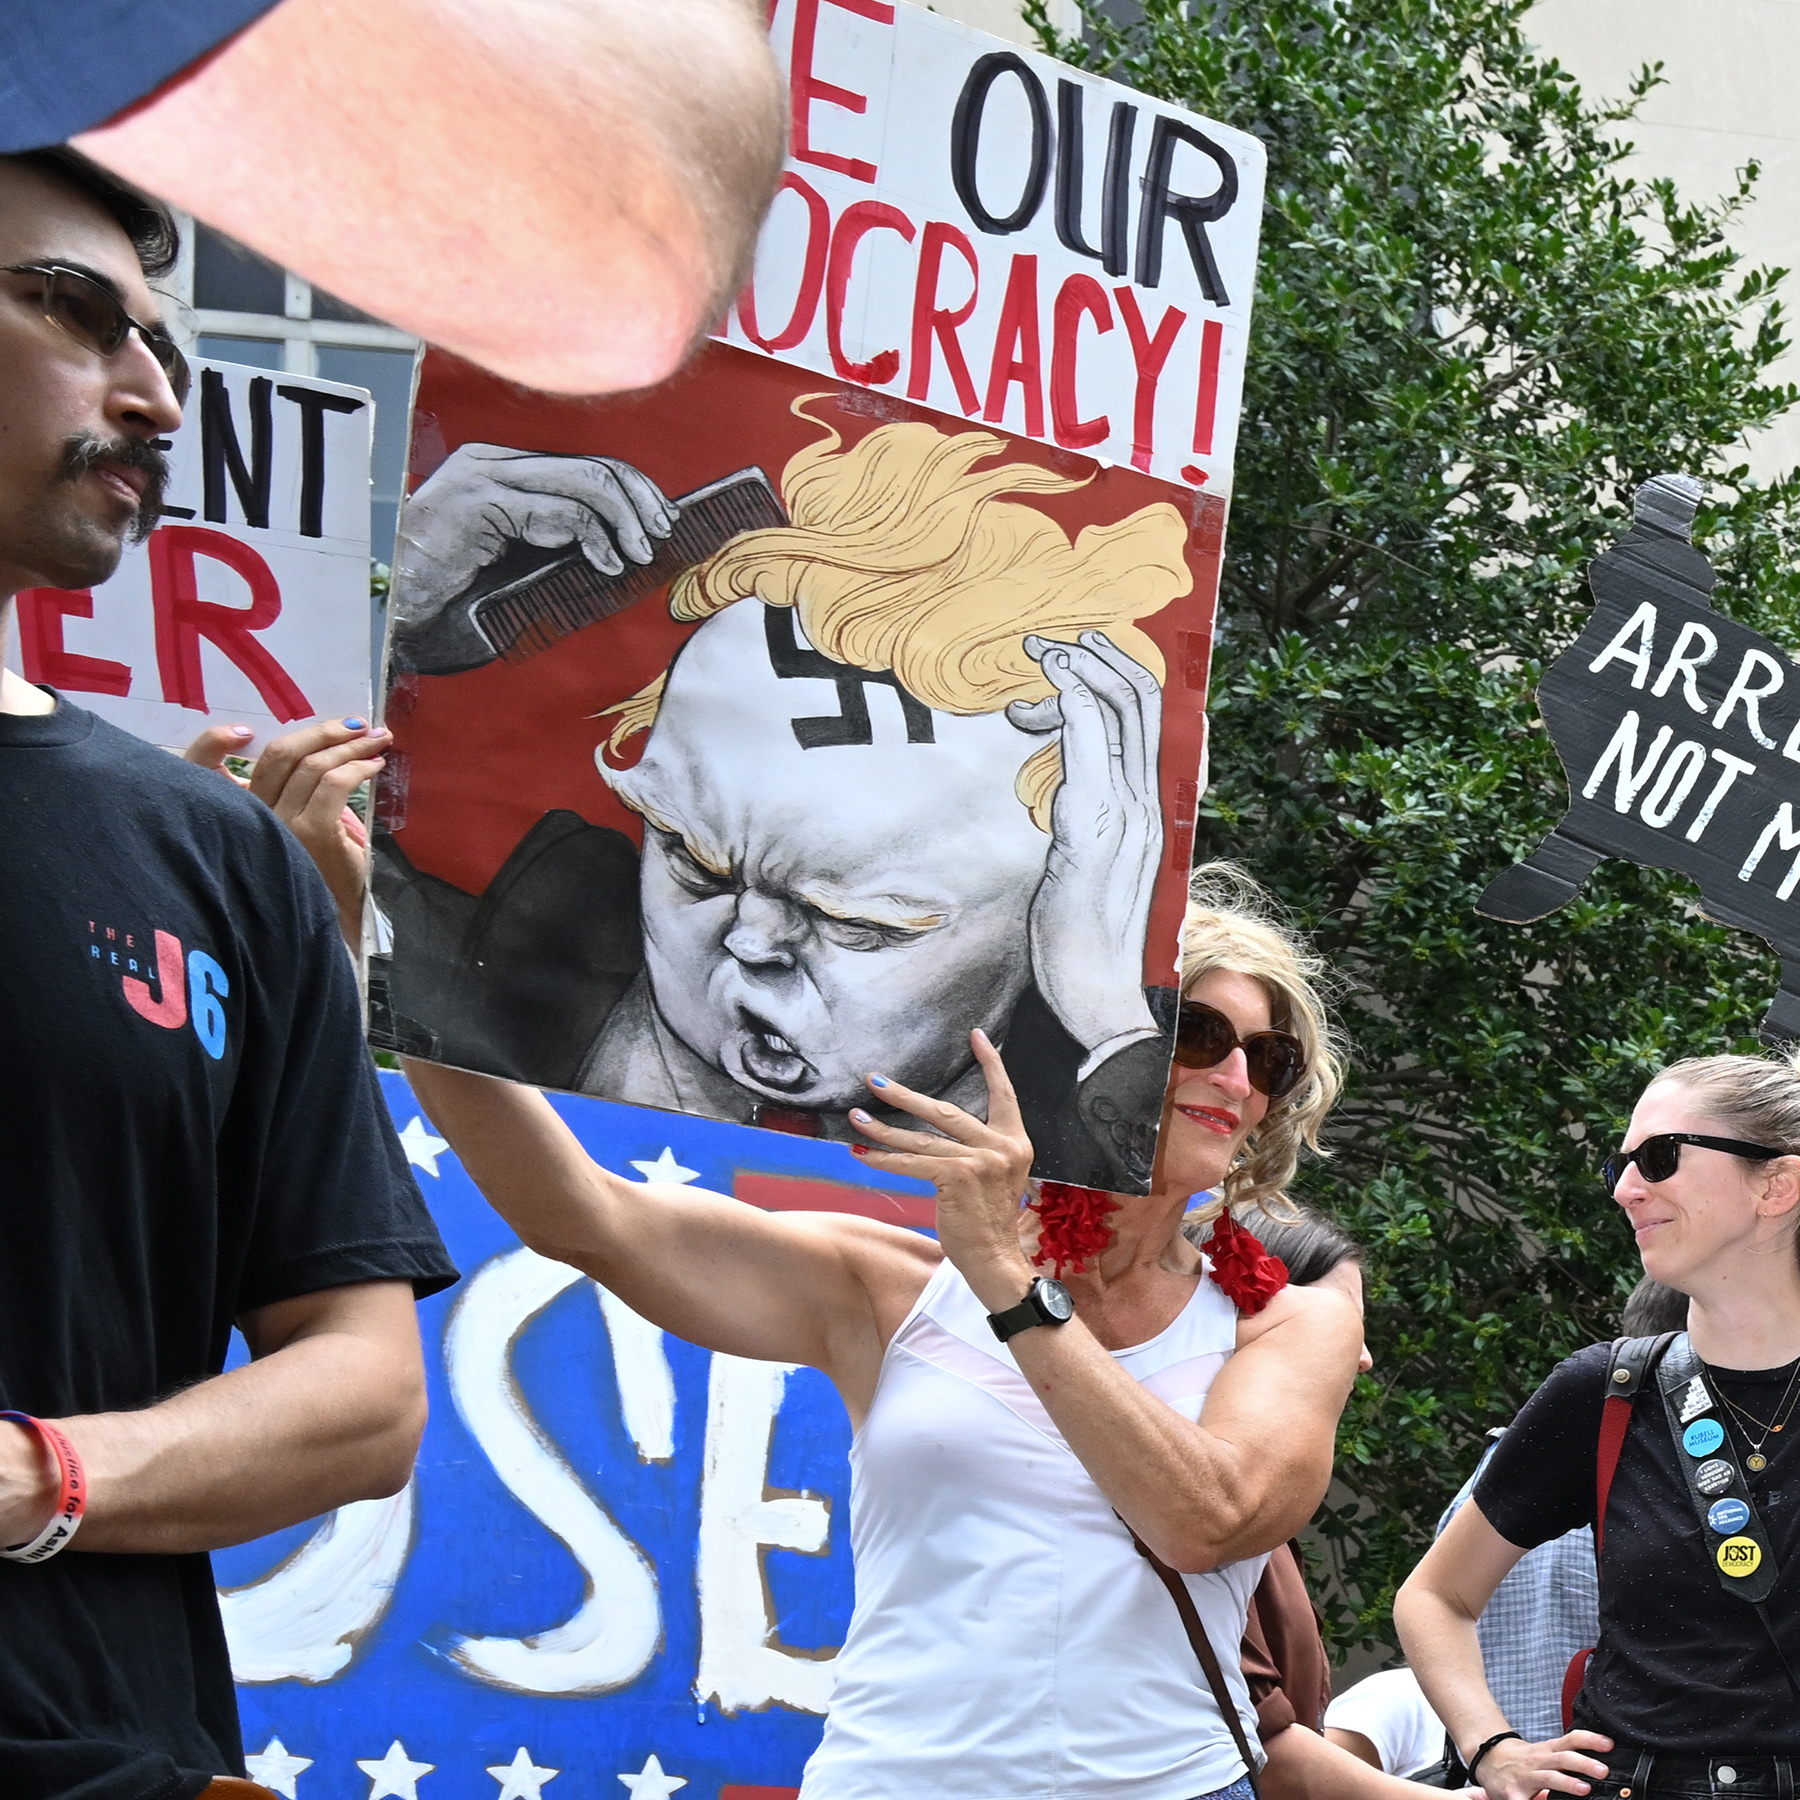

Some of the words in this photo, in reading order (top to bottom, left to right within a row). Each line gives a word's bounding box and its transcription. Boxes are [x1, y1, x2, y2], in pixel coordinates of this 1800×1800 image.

[768, 0, 895, 184] E
[950, 50, 1238, 307] OUR
[708, 171, 1224, 487] OCRACY!
[150, 366, 366, 538] NT
[1582, 710, 1756, 843] NOT
[88, 919, 135, 948] THE
[91, 944, 156, 979] REAL
[122, 928, 229, 1060] J6
[1687, 1395, 1707, 1409] BLACK
[1689, 1402, 1711, 1416] WOMEN
[1688, 1434, 1719, 1447] MUSEUM
[63, 1495, 82, 1523] for
[1716, 1507, 1744, 1516] NATIONAL
[1718, 1515, 1744, 1525] ALLIANCE
[27, 1525, 69, 1563] Ashli
[1722, 1545, 1756, 1562] JUST
